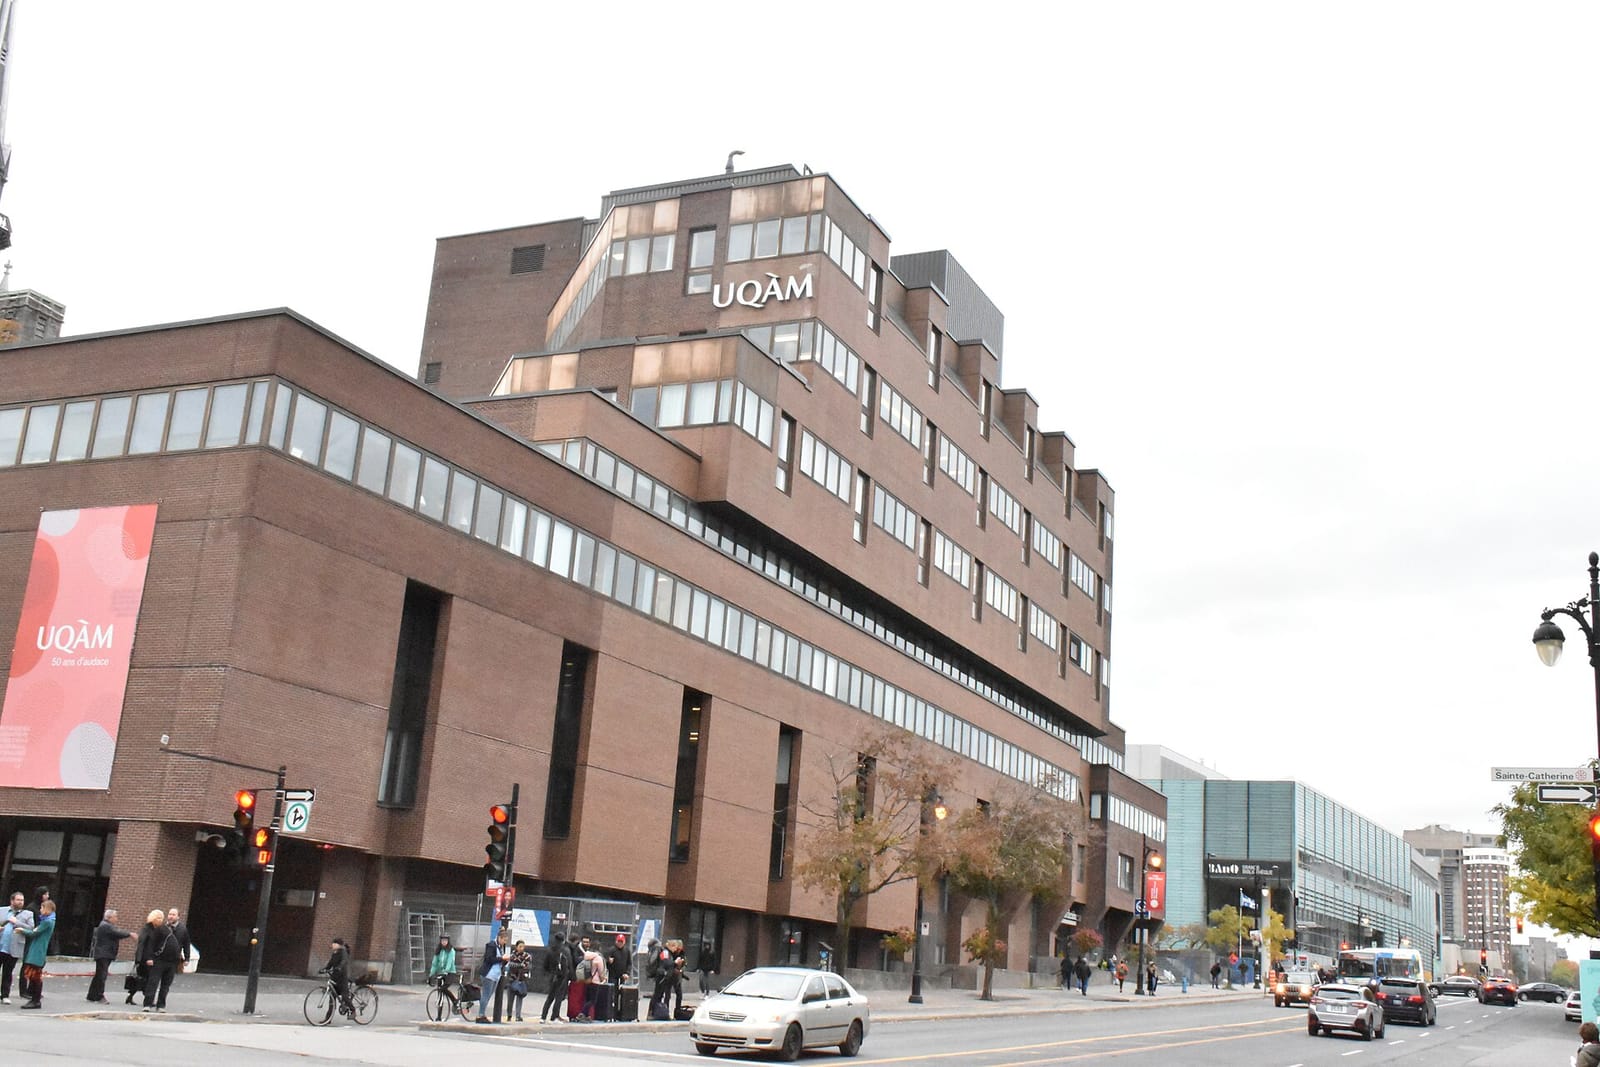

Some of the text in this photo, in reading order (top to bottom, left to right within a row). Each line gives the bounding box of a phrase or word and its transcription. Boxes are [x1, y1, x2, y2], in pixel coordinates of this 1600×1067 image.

[712, 272, 813, 308] UQÀM
[36, 619, 114, 654] UQÀM
[51, 656, 62, 667] 50
[77, 656, 110, 666] d'audace
[1495, 771, 1575, 780] Sainte-Catherine
